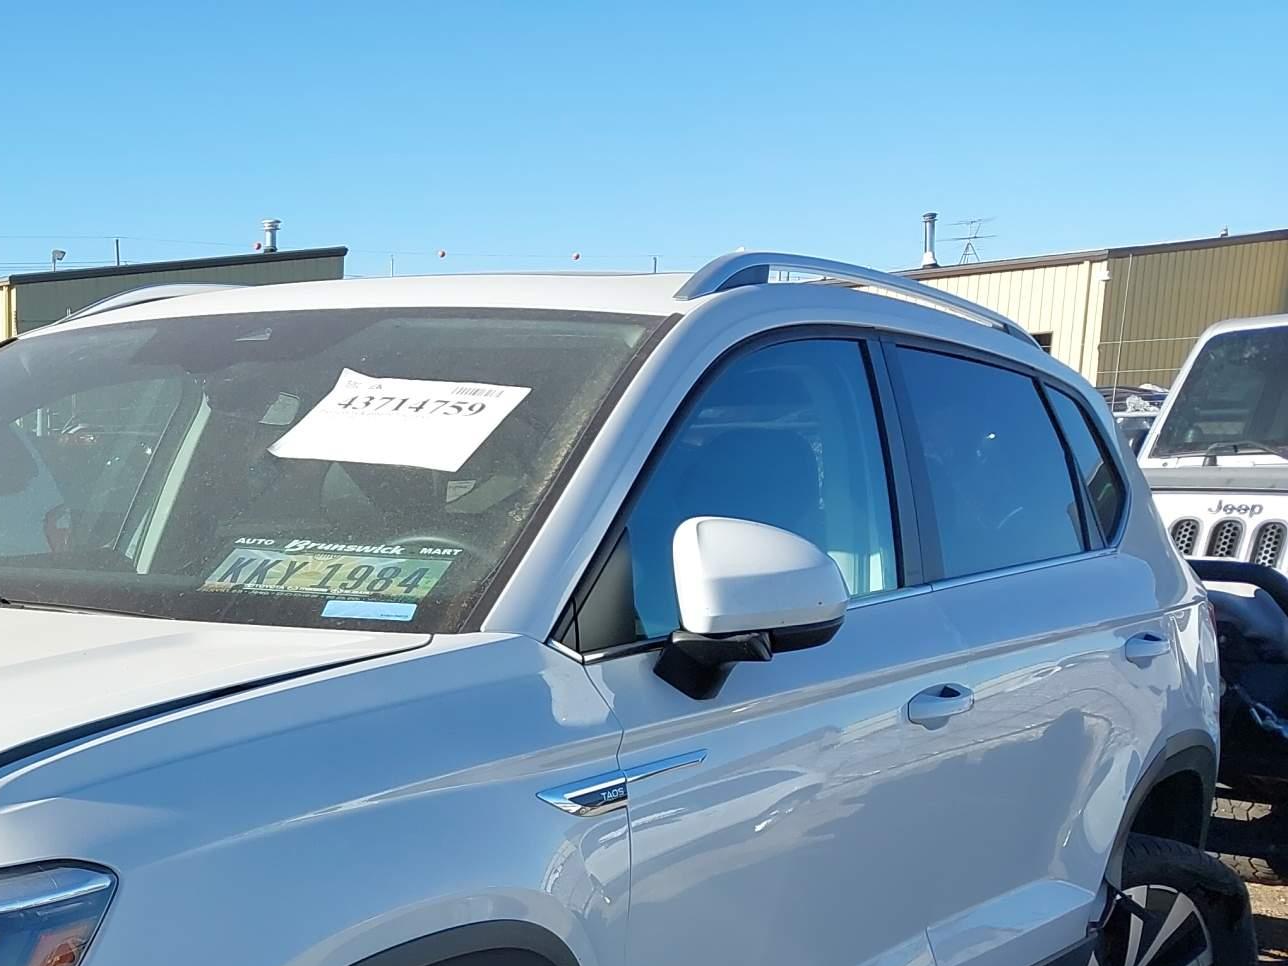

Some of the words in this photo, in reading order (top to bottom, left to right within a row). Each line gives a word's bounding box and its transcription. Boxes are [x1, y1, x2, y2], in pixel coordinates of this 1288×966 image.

[337, 395, 487, 417] 43714759
[1208, 500, 1263, 518] Jeep
[235, 537, 276, 546] AUTO
[284, 539, 406, 556] Brunswick
[419, 547, 463, 556] MART
[216, 556, 309, 591] KKY
[309, 563, 429, 595] 1984
[600, 787, 625, 801] TAOS
